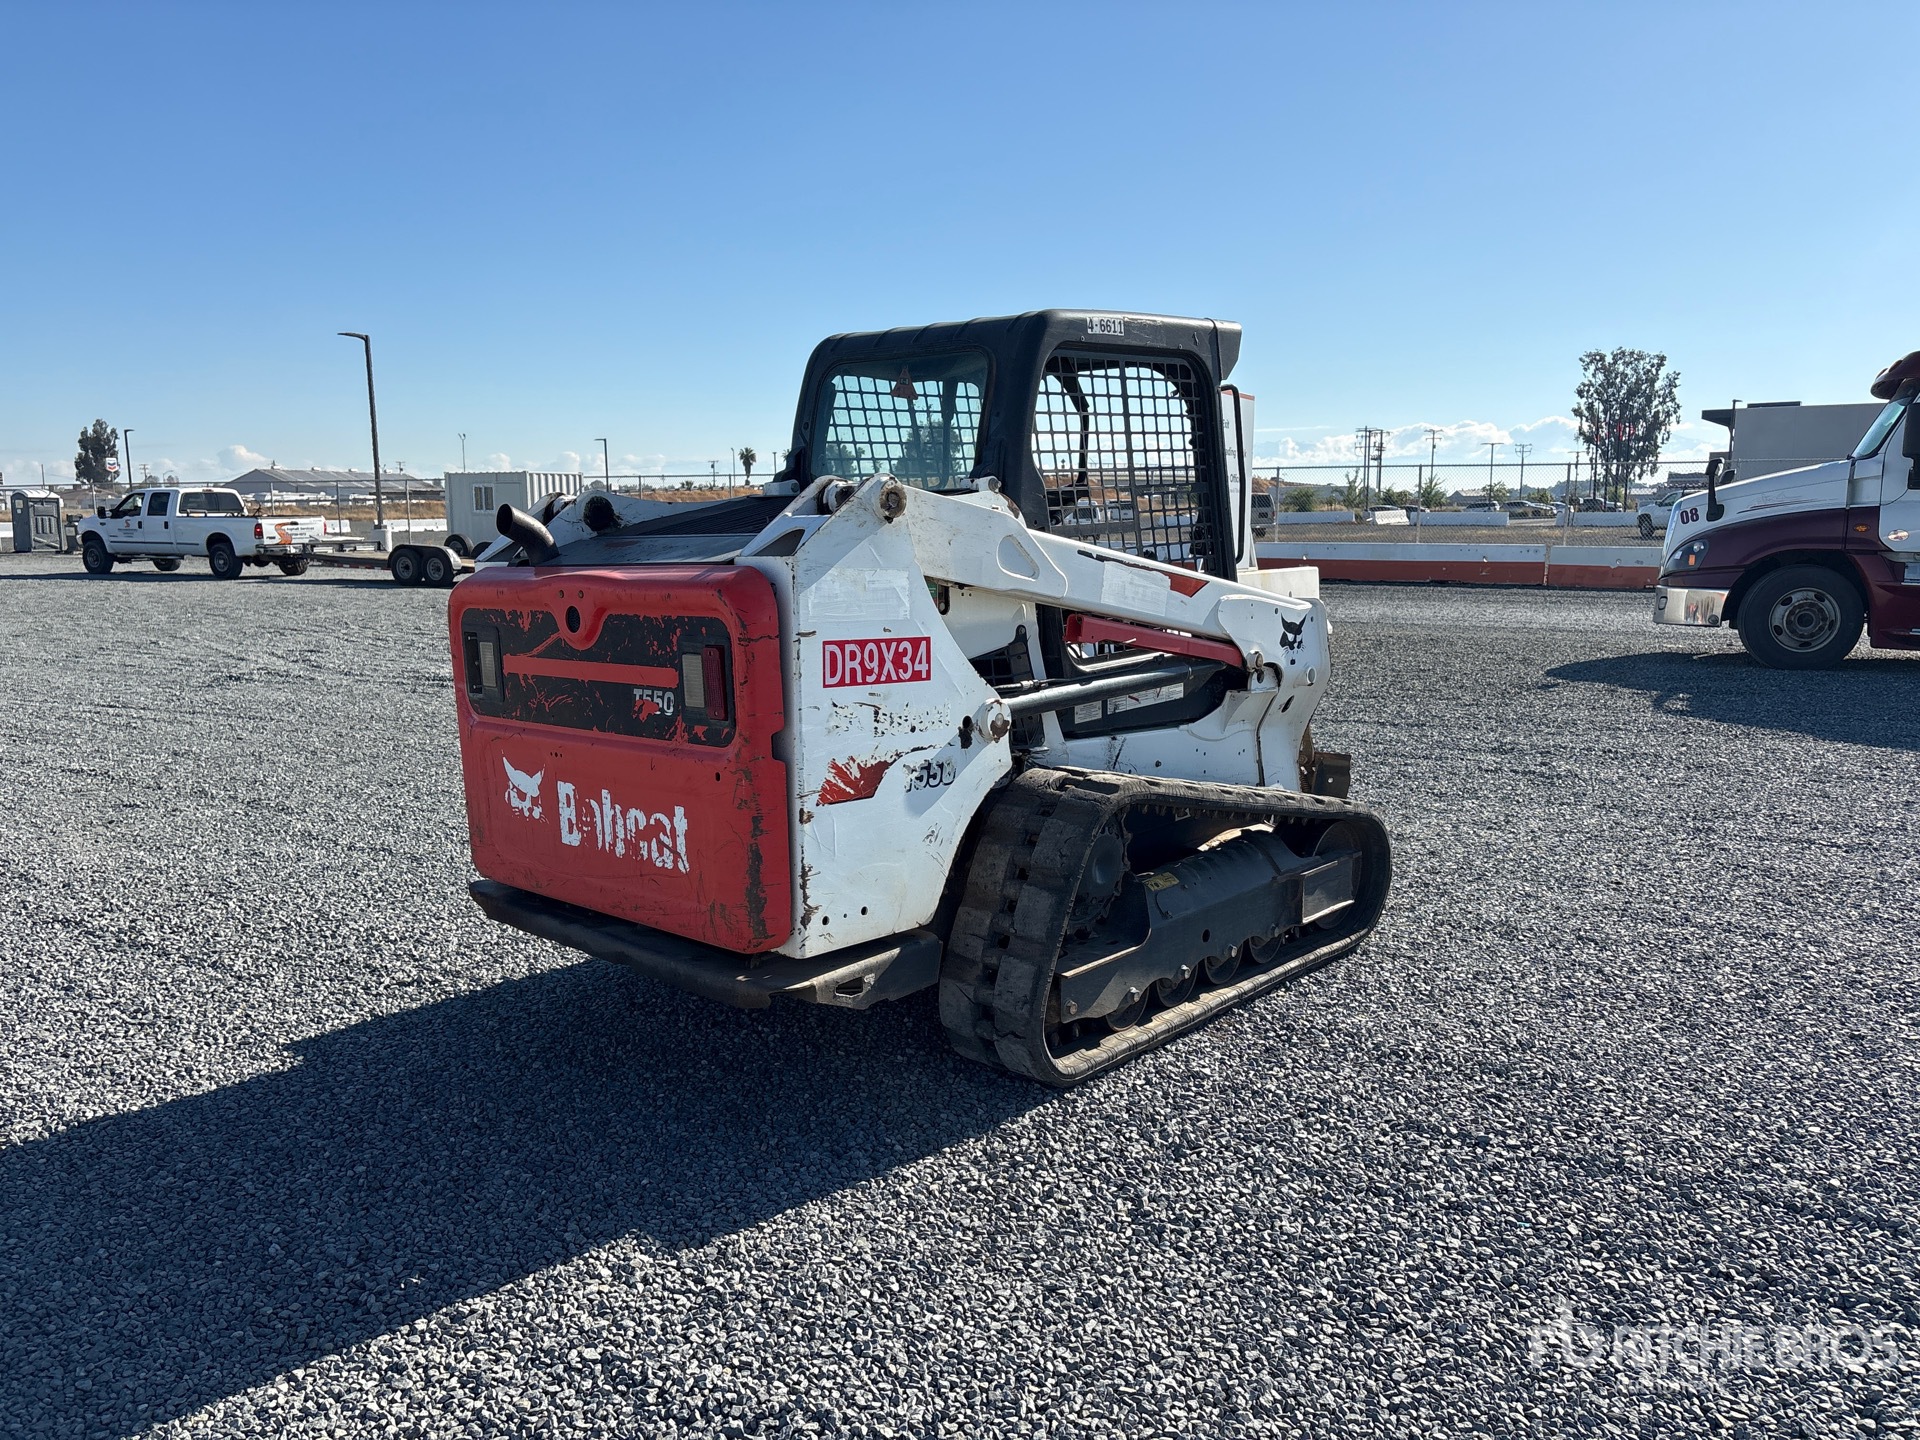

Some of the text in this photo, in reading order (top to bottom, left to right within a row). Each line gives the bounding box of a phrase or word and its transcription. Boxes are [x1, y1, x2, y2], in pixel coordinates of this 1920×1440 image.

[1088, 318, 1124, 335] 4-6611
[1680, 507, 1699, 525] 08
[825, 641, 929, 685] DR9X34
